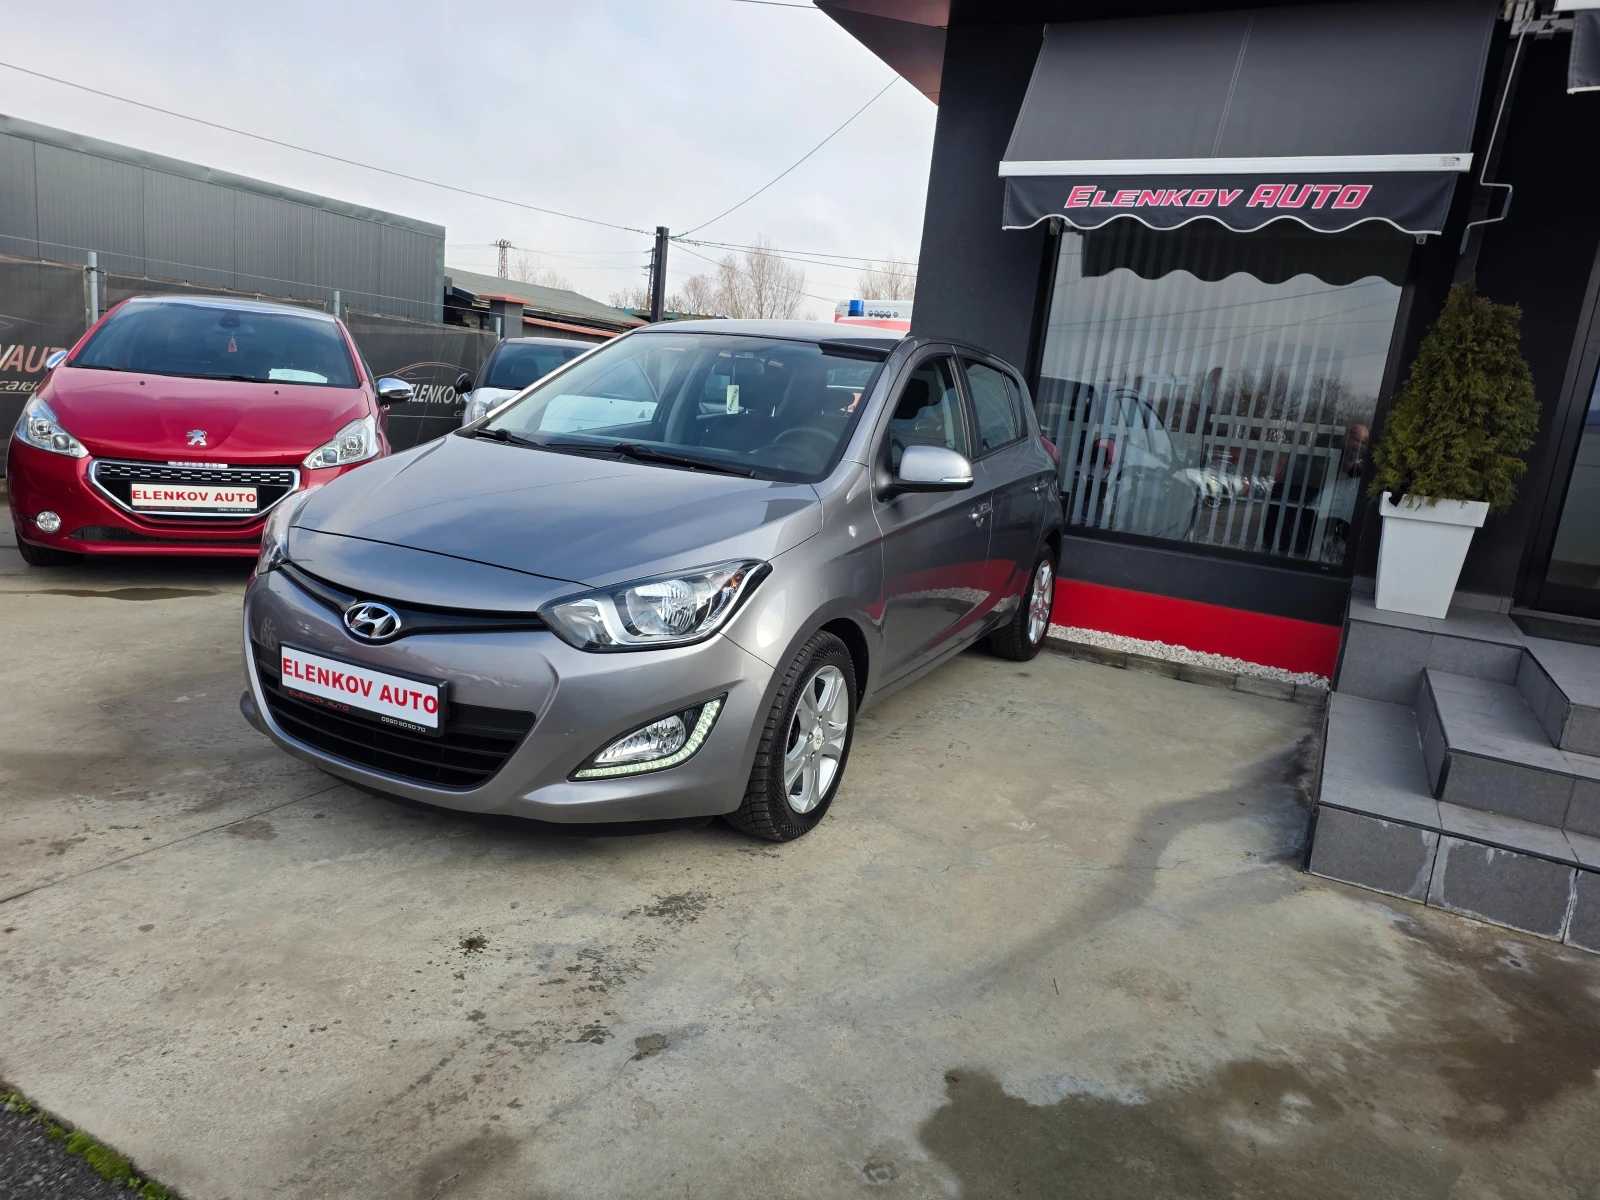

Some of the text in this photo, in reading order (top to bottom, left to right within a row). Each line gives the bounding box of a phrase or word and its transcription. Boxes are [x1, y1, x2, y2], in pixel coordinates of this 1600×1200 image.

[1064, 183, 1373, 209] ELENKOV AUTO
[132, 490, 257, 503] ELENKOV AUTO
[282, 657, 439, 714] ELENKOV AUTO
[288, 689, 350, 712] ELENKOV AUTO
